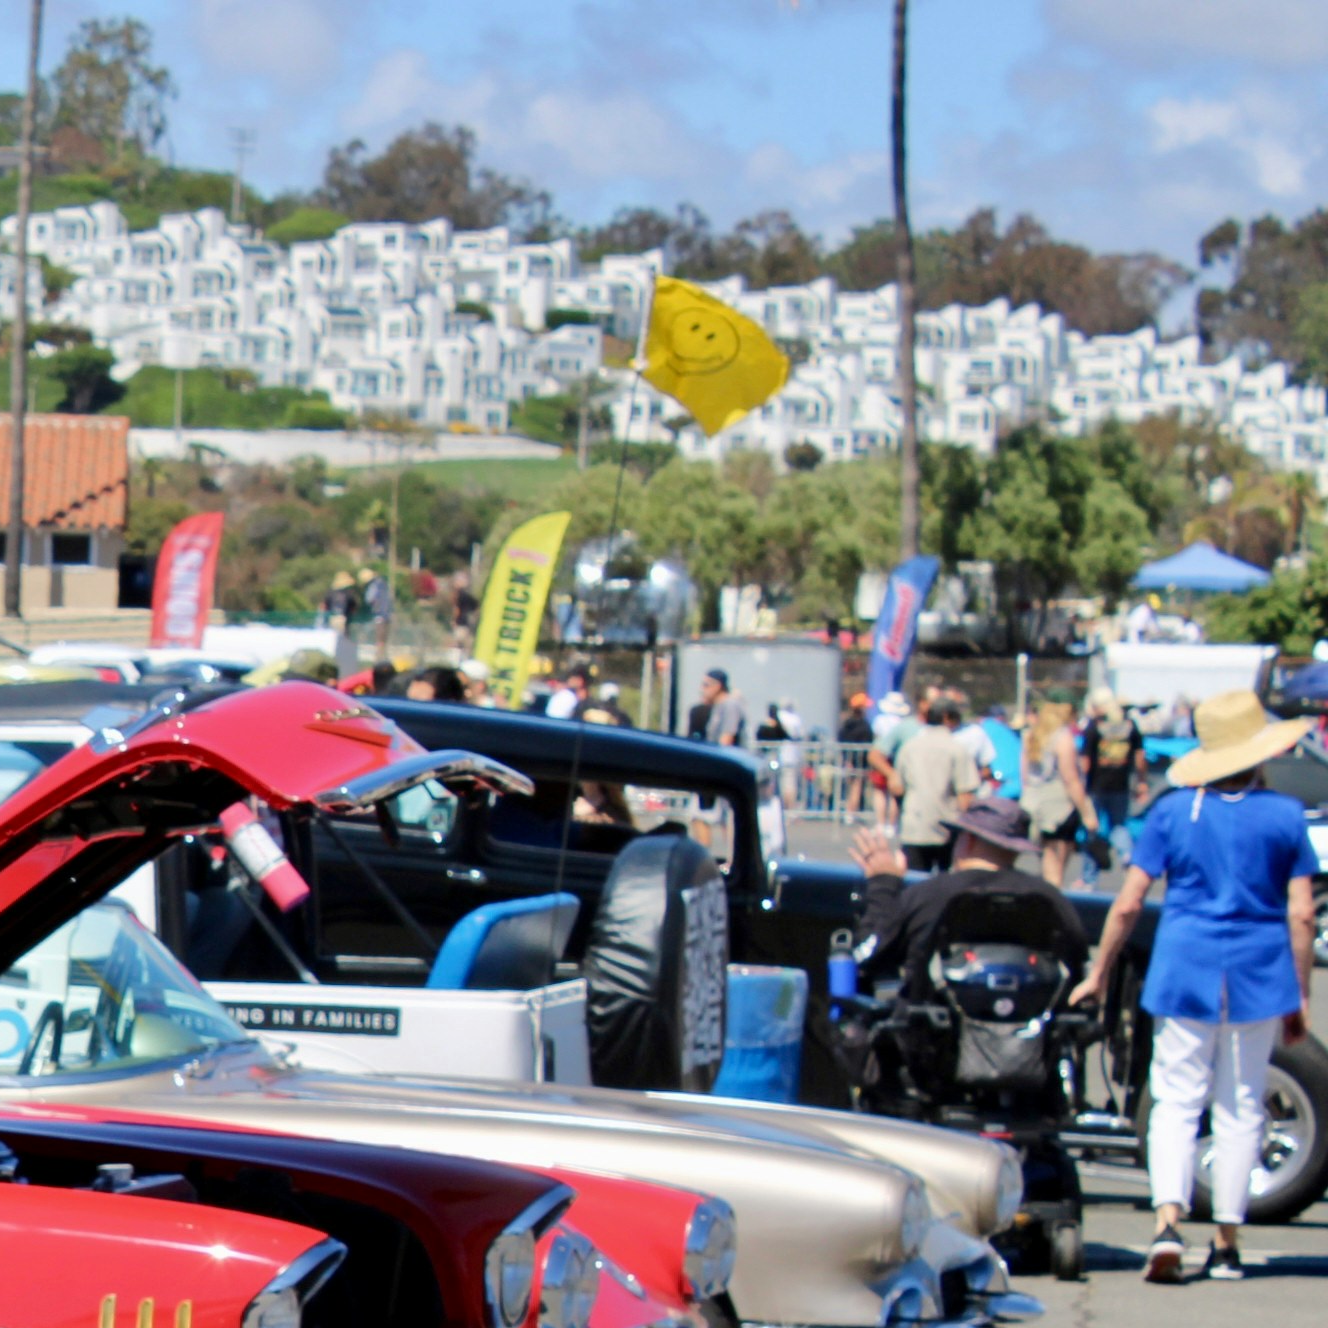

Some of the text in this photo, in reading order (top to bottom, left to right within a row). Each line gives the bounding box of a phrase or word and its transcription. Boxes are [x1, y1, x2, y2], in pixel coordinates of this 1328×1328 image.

[496, 568, 534, 655] TRUCK
[272, 1008, 295, 1026] IN
[302, 1011, 397, 1031] FAMILIES
